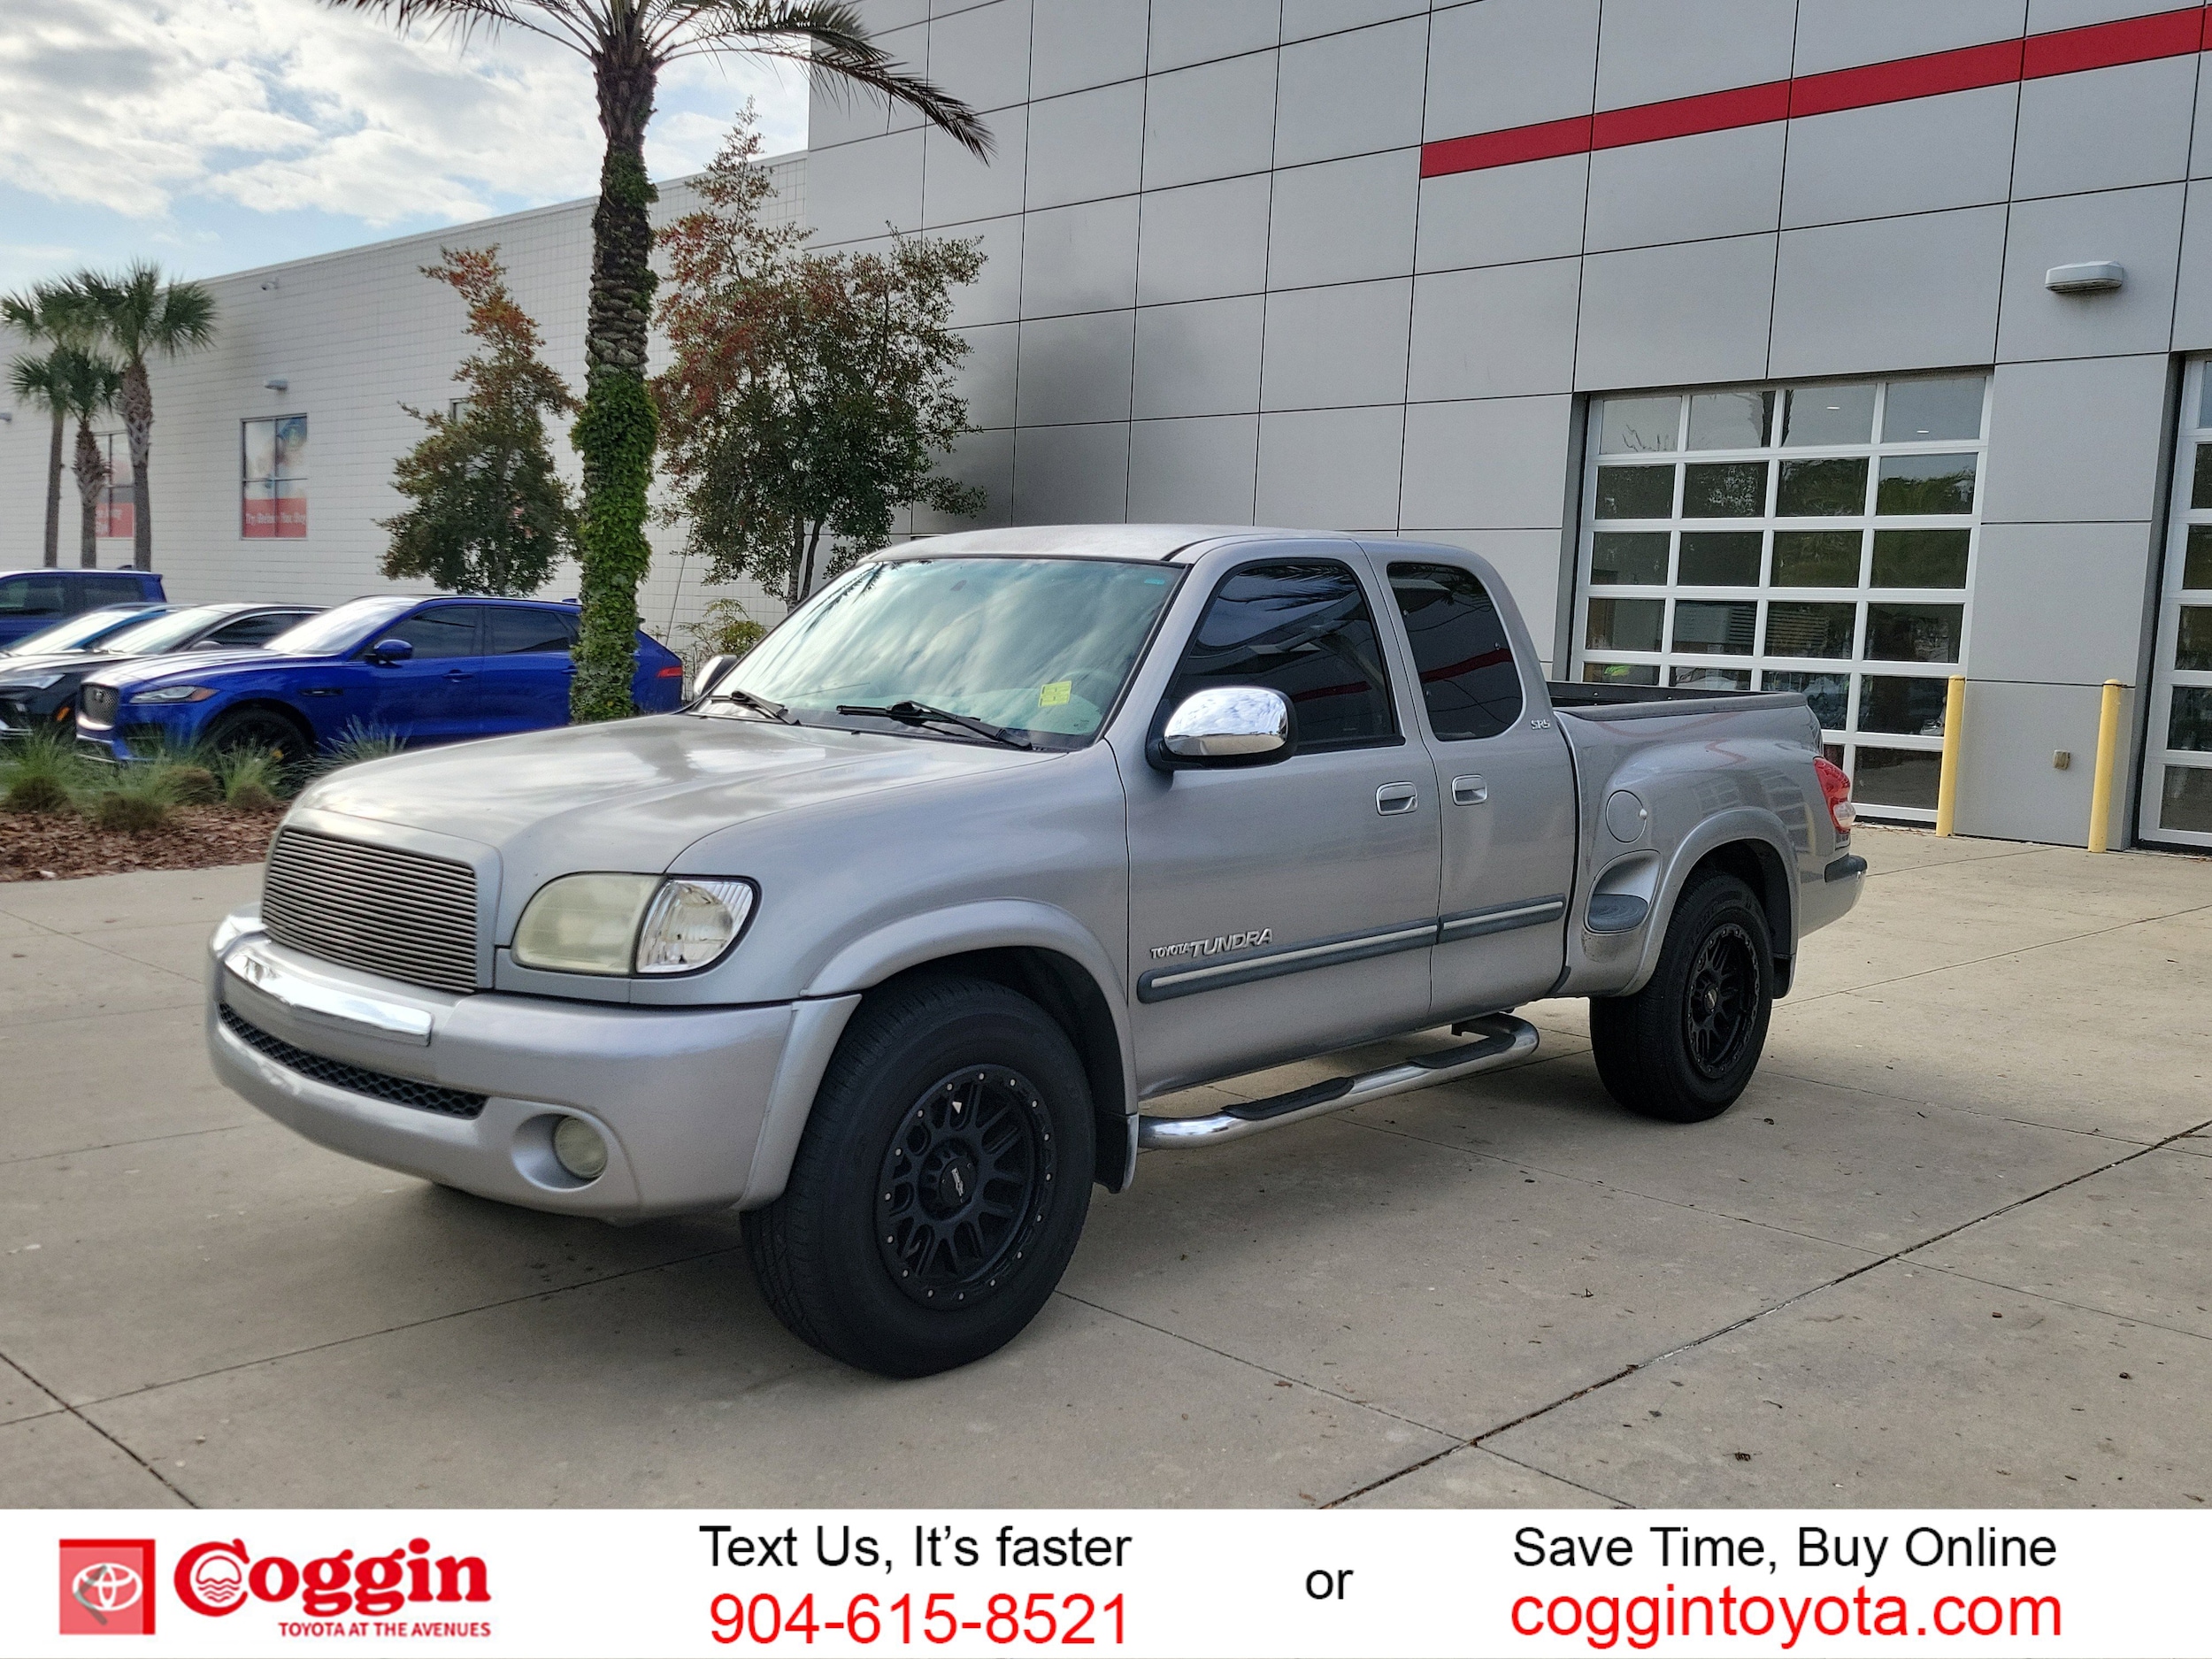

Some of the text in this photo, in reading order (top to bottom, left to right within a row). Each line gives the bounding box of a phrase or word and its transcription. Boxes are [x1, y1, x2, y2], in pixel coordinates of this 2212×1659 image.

[1531, 718, 1550, 730] SR5
[1150, 927, 1273, 959] TOYOTA TUNDRA
